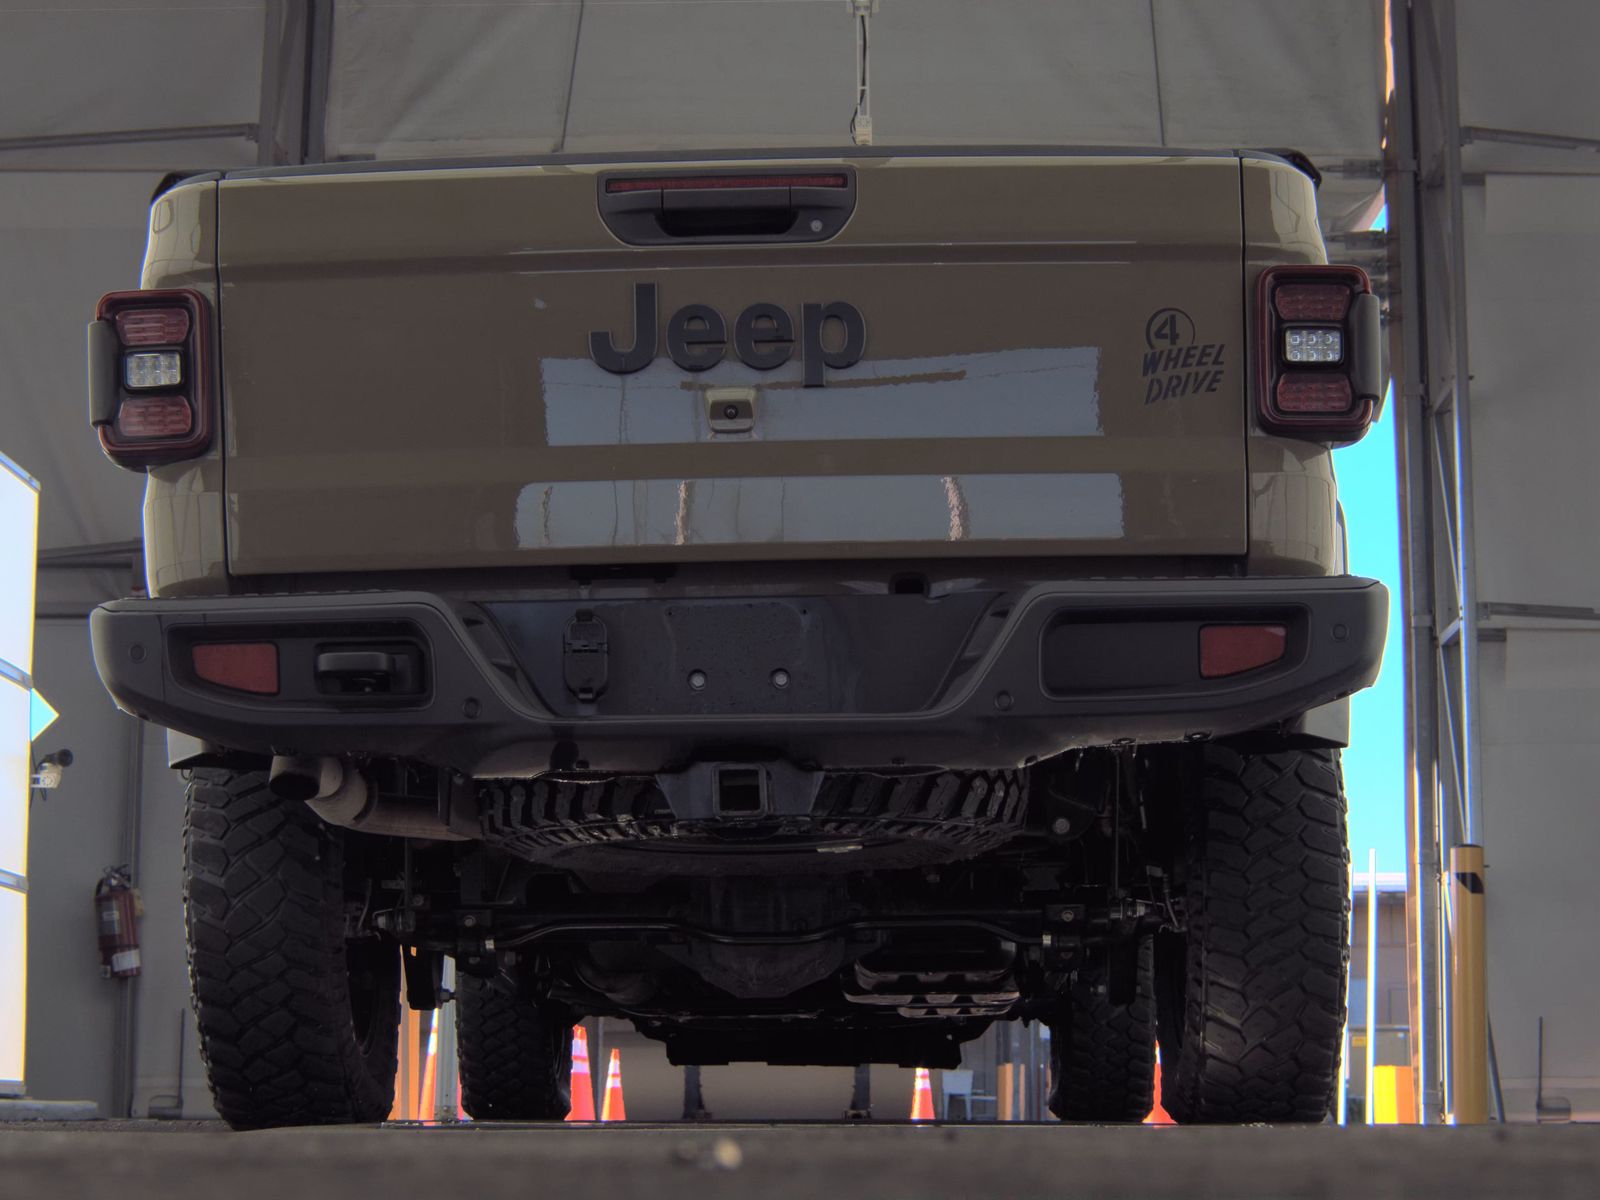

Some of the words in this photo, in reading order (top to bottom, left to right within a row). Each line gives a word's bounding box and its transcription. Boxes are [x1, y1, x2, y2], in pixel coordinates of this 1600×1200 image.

[589, 282, 866, 387] Jeep
[1154, 314, 1180, 346] 4
[1142, 344, 1225, 377] WHEEL
[1144, 370, 1224, 405] DRIVE
